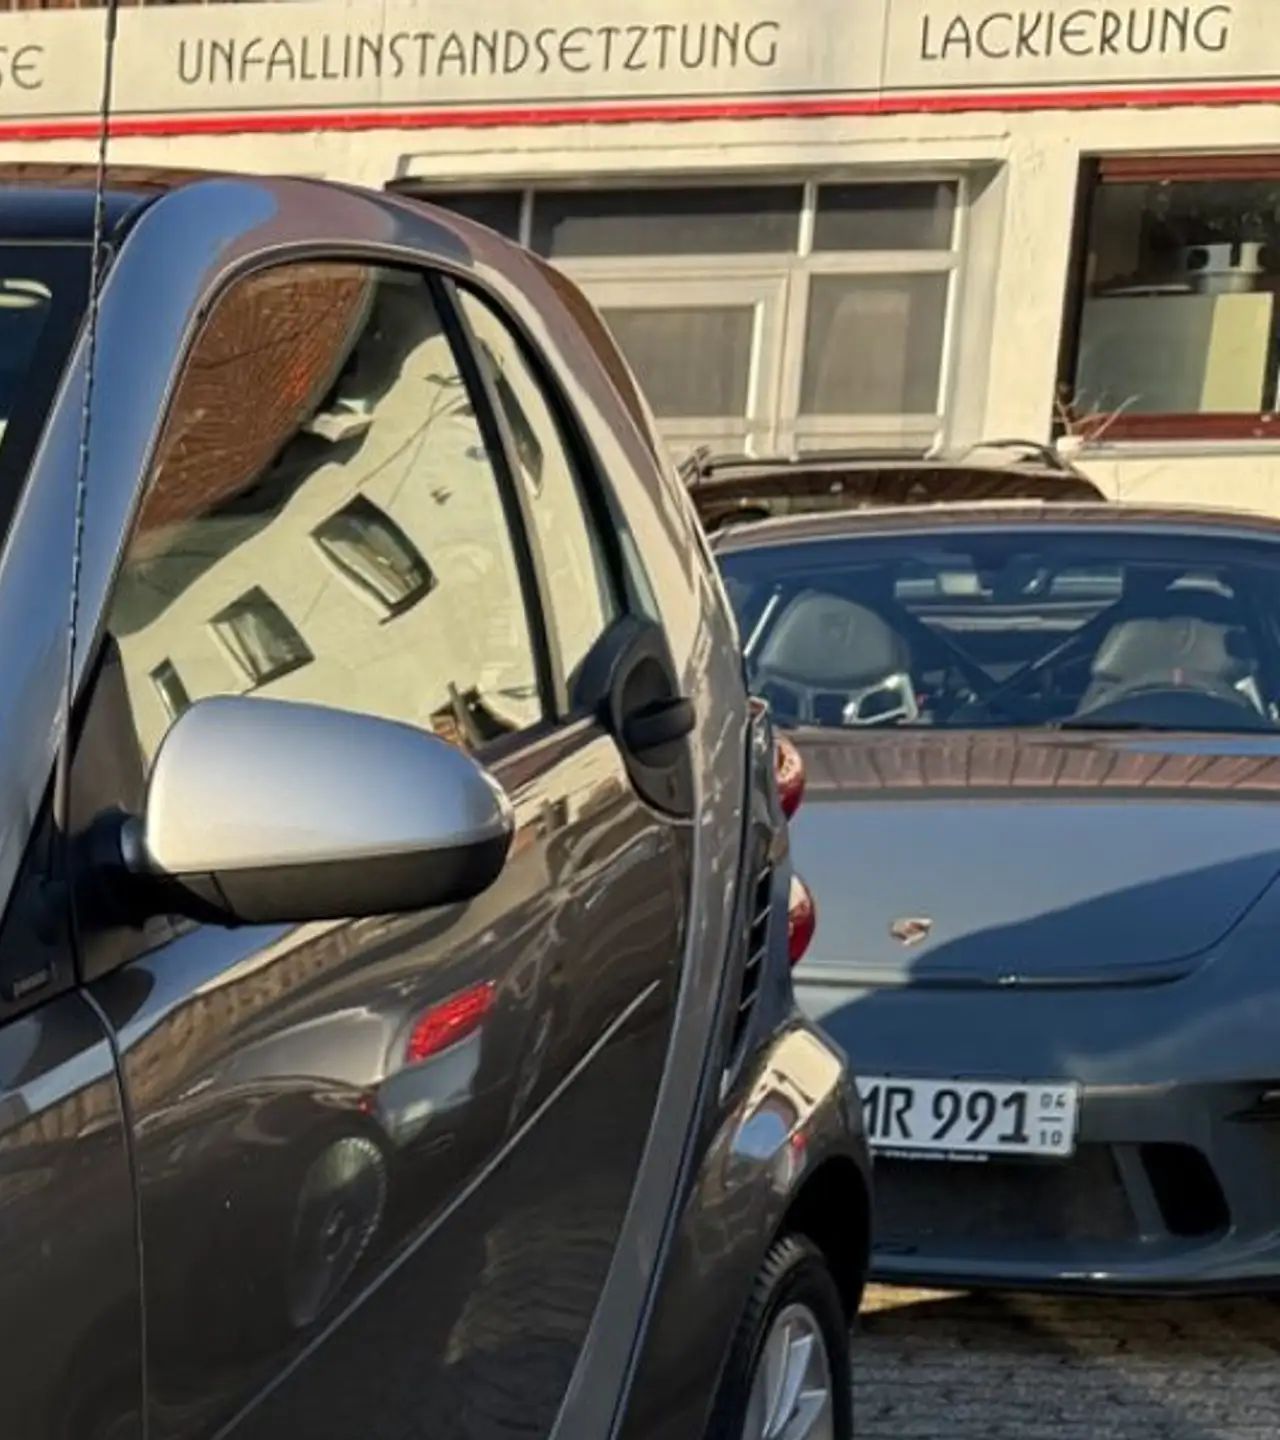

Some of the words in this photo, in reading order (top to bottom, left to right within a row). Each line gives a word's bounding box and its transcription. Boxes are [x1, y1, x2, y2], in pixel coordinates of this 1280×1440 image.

[176, 19, 782, 86] UNFALLINSTANDSETZTUNG
[919, 3, 1234, 62] LACKIERUNG
[930, 1087, 1030, 1145] 991
